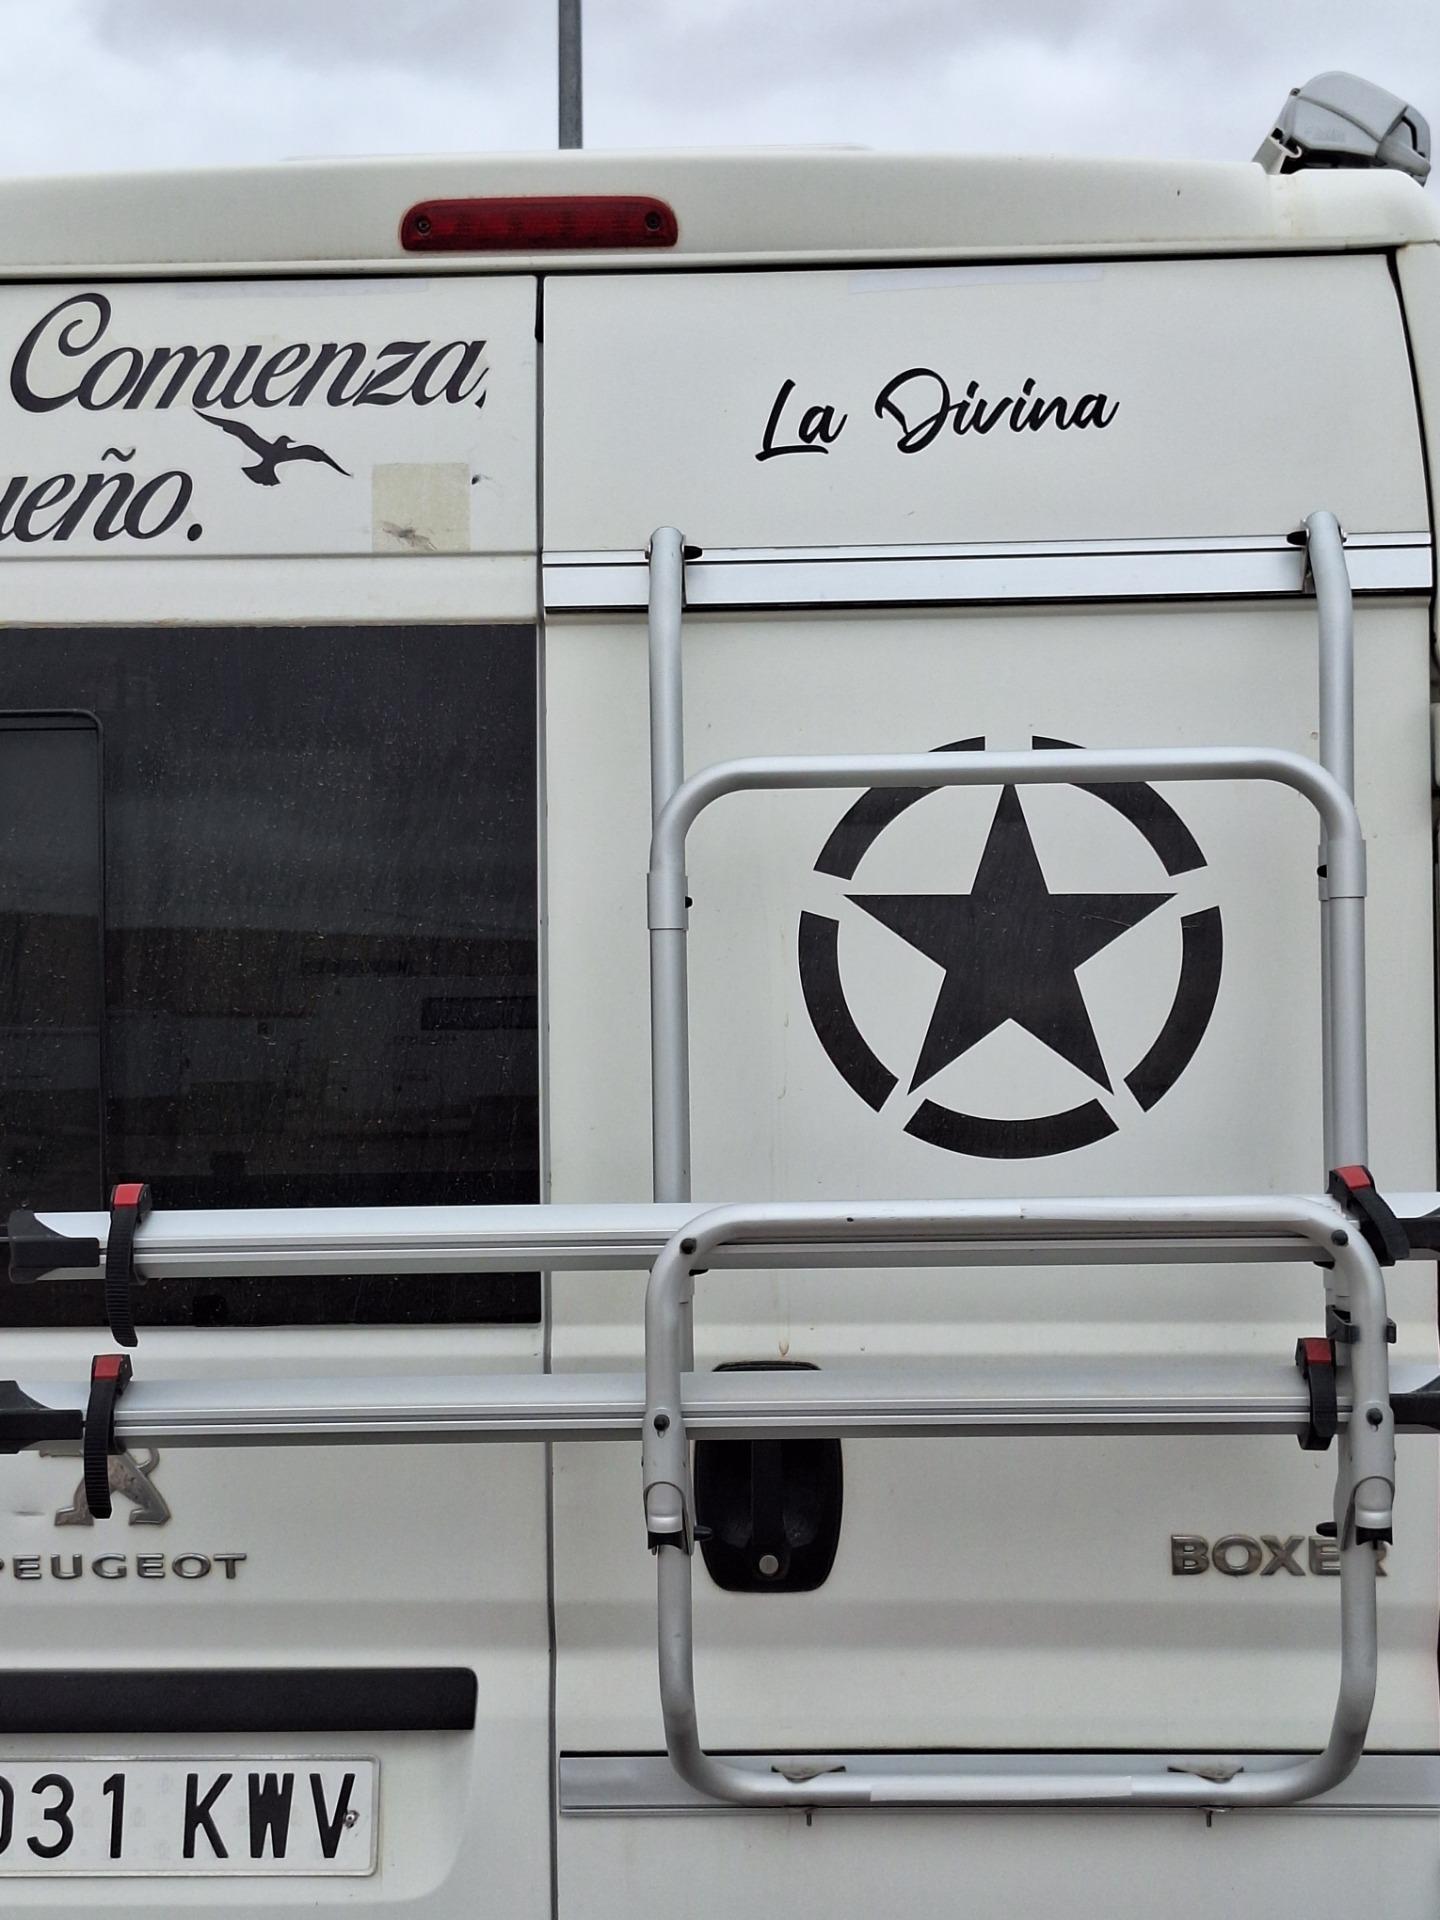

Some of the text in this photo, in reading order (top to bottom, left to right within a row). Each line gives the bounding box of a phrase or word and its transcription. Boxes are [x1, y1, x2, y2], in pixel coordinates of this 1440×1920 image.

[756, 367, 1121, 462] La Divina
[0, 1552, 248, 1581] EUGEOT
[182, 1773, 359, 1859] KWV
